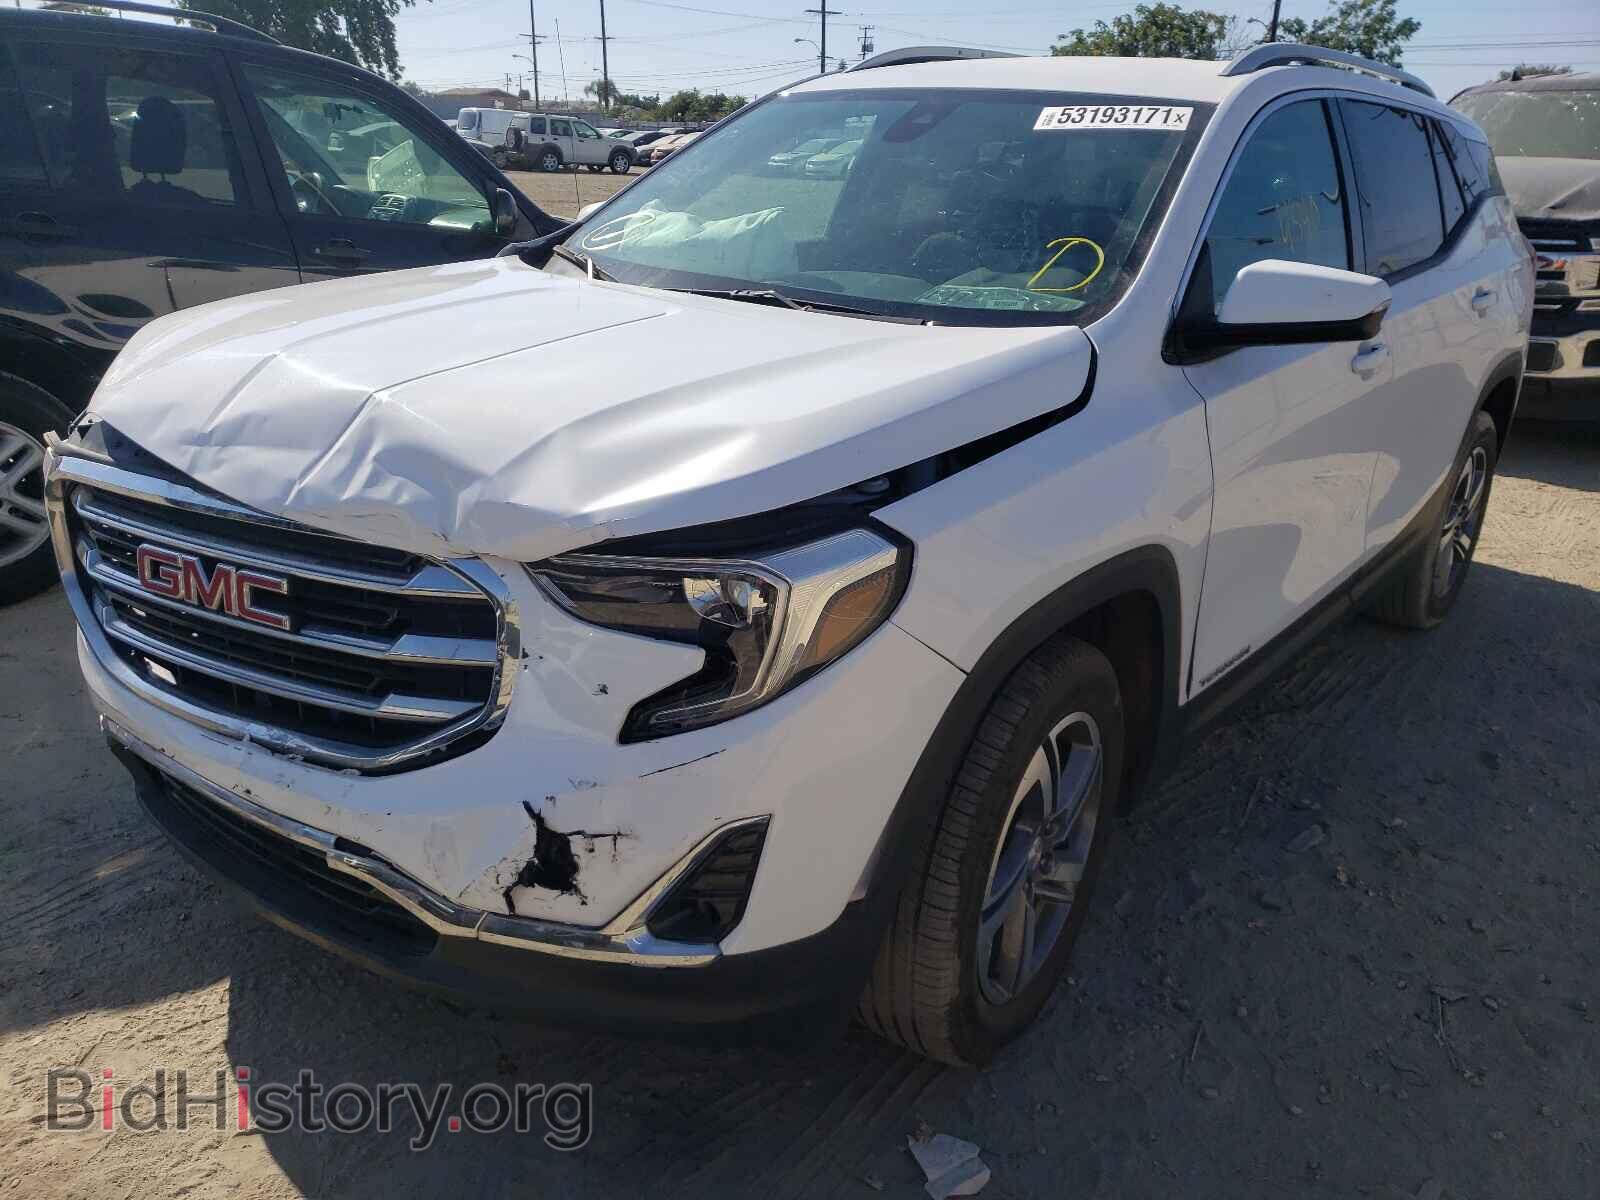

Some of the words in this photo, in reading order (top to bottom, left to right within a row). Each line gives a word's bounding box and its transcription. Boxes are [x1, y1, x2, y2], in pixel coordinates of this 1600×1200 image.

[1057, 106, 1173, 124] 53193171
[1025, 237, 1105, 291] D
[137, 543, 291, 631] GMC
